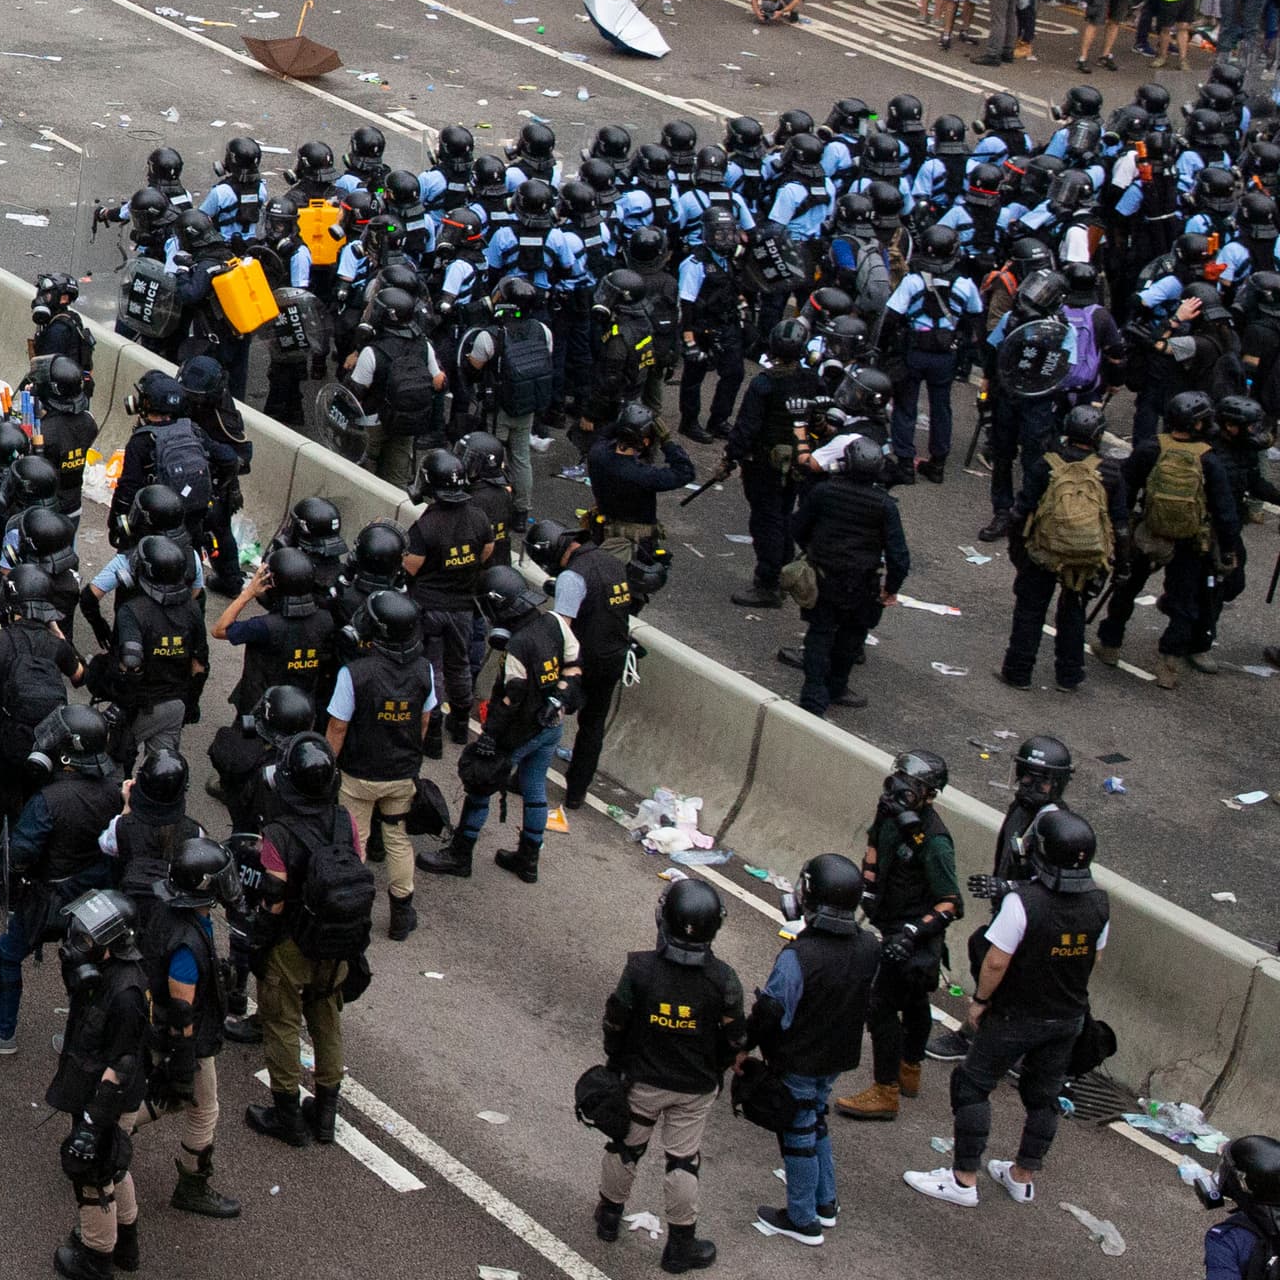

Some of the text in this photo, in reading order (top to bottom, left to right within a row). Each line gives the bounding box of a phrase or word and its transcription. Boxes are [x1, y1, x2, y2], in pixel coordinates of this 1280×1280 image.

[766, 239, 790, 278] POLICE
[143, 280, 160, 322] POLICE
[287, 306, 308, 348] POLICE
[1041, 351, 1059, 376] POLICE
[445, 553, 475, 567] POLICE
[610, 593, 631, 606] POLIC
[287, 659, 319, 670] POLICE
[377, 712, 411, 721] POLICE
[239, 865, 261, 889] LICE
[1050, 946, 1088, 957] POLICE
[649, 1014, 697, 1030] POLICE
